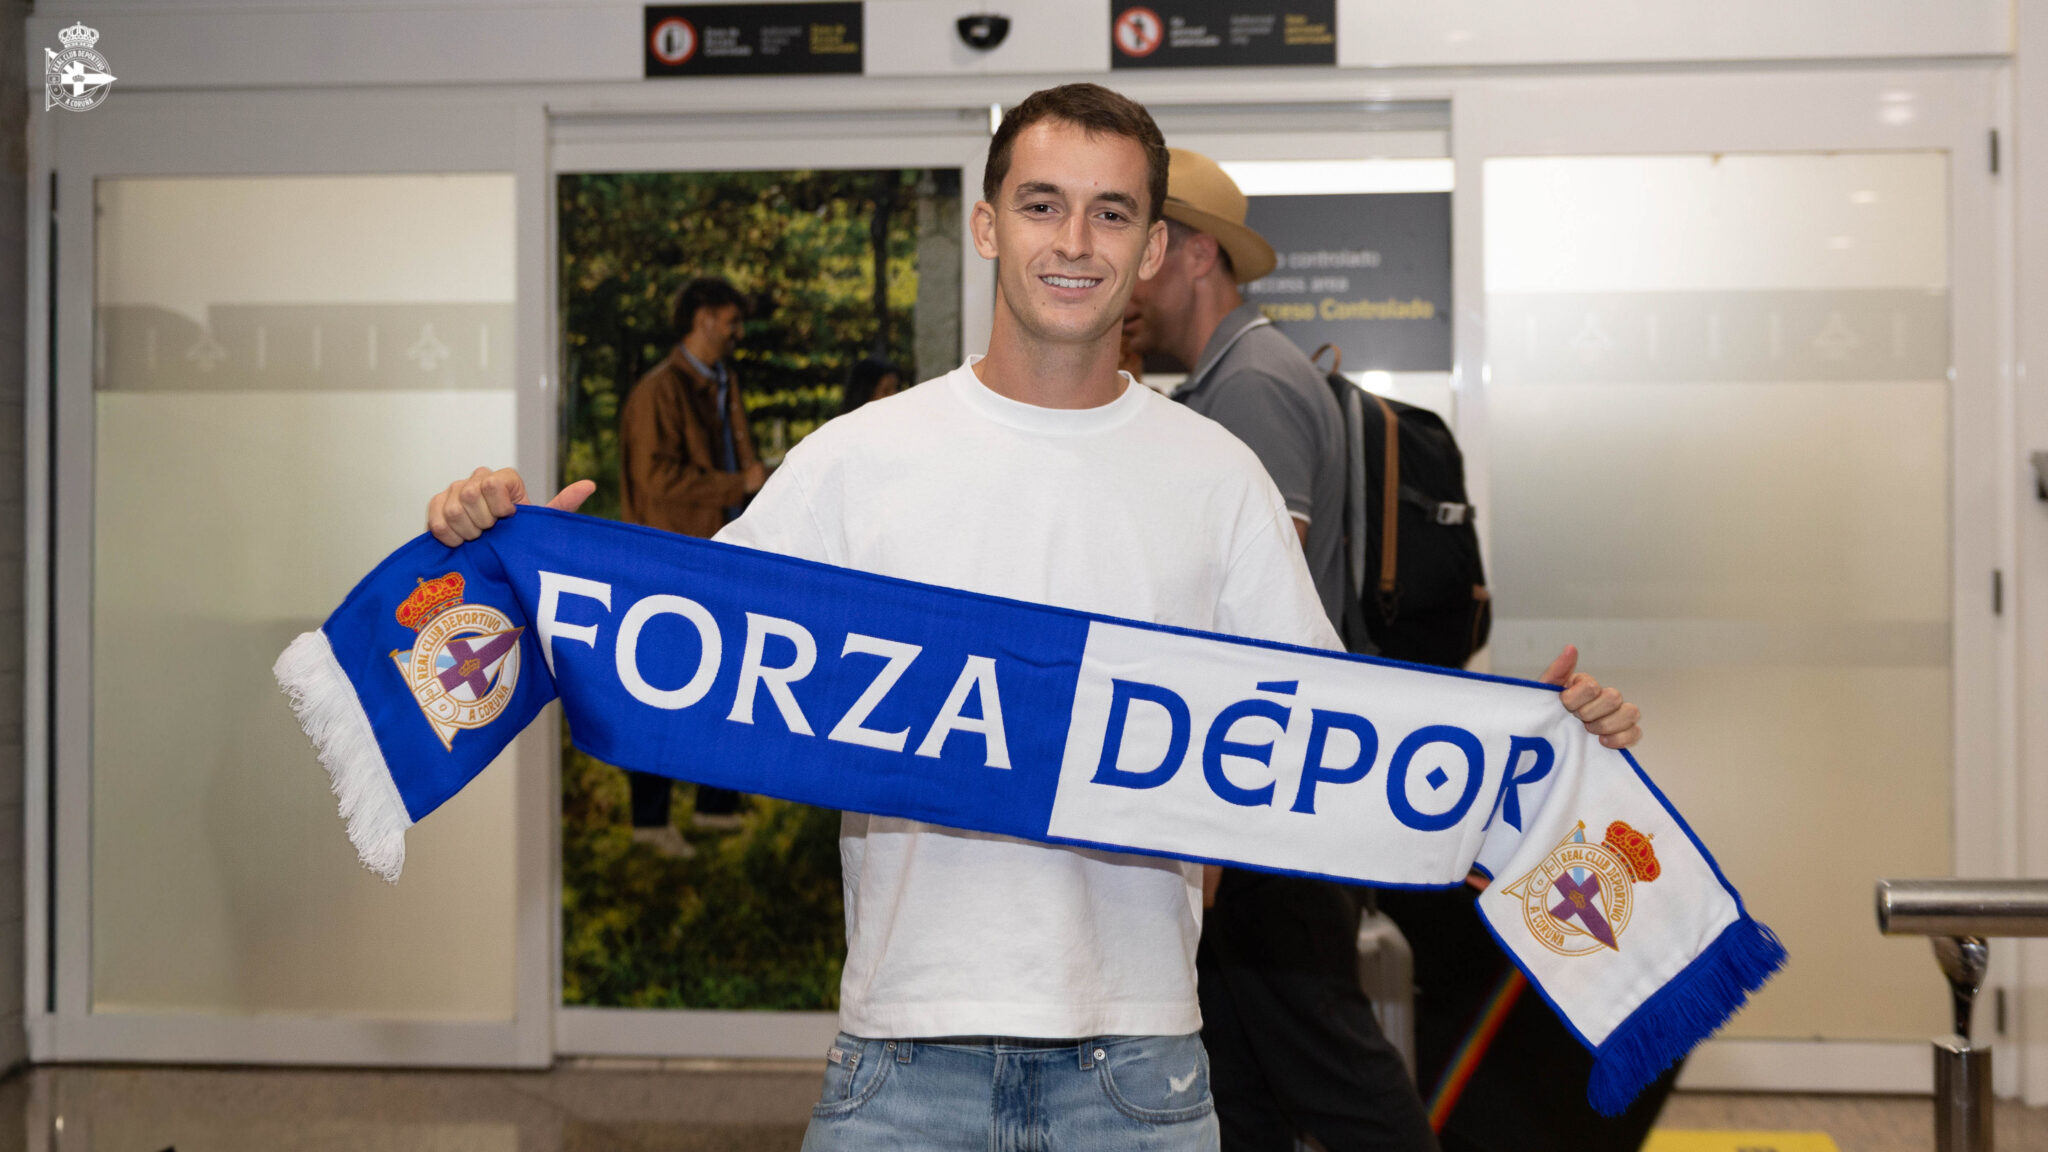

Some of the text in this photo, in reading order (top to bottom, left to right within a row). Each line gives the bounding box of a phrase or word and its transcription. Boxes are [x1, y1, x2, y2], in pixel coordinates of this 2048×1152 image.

[417, 612, 501, 680] REAL CLUB DEPORTIVO
[537, 570, 1012, 770] FORZA
[469, 708, 476, 721] A
[1530, 906, 1540, 914] A
[1561, 849, 1625, 922] REAL CLUB DEPORTIVO
